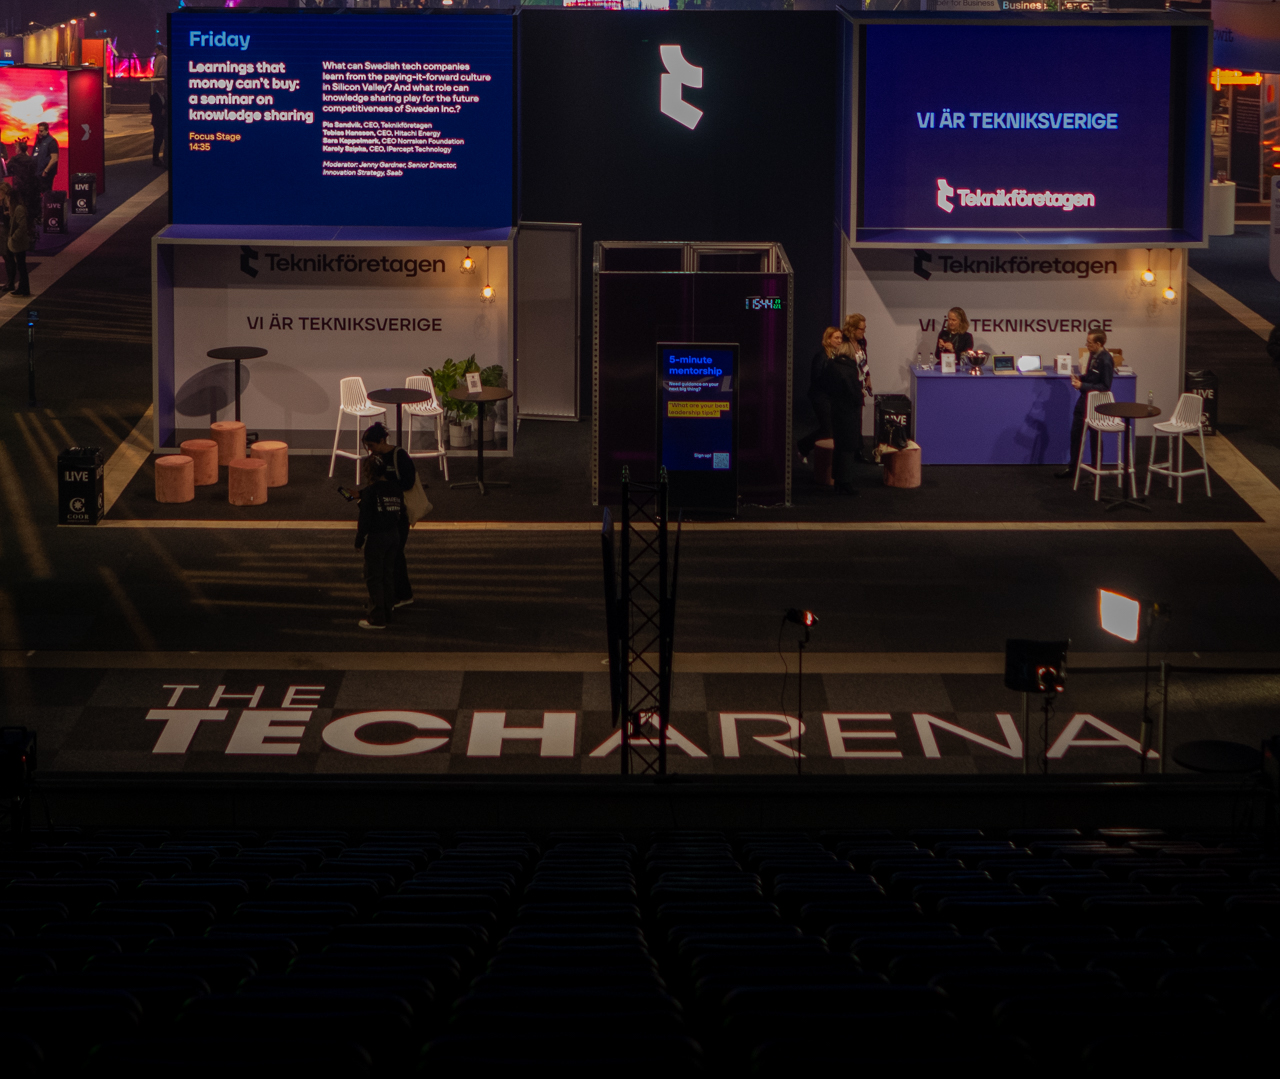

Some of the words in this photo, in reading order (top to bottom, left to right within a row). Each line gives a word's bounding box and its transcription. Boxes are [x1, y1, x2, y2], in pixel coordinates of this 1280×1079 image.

[189, 30, 251, 51] Friday
[188, 60, 255, 75] Learnings
[256, 61, 286, 73] that
[322, 61, 346, 70] What
[347, 62, 363, 70] can
[364, 61, 400, 70] Swedish
[401, 61, 421, 70] tech
[422, 62, 470, 72] companies
[322, 72, 345, 81] learn
[346, 72, 366, 81] from
[368, 72, 382, 81] the
[384, 73, 459, 83] paying-it-forward
[460, 73, 491, 82] culture
[188, 78, 234, 91] money
[235, 77, 270, 89] can't
[272, 77, 300, 92] buy:
[322, 82, 331, 91] in
[332, 82, 360, 91] Silicon
[362, 83, 392, 93] Valley?
[393, 83, 411, 91] And
[412, 83, 434, 92] what
[435, 83, 452, 92] role
[188, 94, 198, 105] a
[200, 92, 255, 105] seminar
[255, 94, 274, 105] on
[322, 93, 369, 104] knowledge
[370, 93, 402, 104] sharing
[403, 94, 421, 104] play
[422, 93, 435, 103] for
[436, 94, 451, 103] the
[452, 94, 480, 103] future
[322, 104, 393, 115] competitiveness
[394, 104, 404, 113] of
[405, 105, 439, 113] Sweden
[441, 105, 461, 114] Inc.?
[188, 108, 262, 123] knowledge
[263, 108, 315, 124] sharing
[917, 112, 935, 129] VI
[939, 108, 965, 129] ÄR
[969, 112, 1119, 130] TEKNIKSVERIGE
[363, 121, 380, 130] CEO,
[380, 122, 433, 131] Teknikföretagen
[189, 131, 215, 141] Focus
[216, 131, 241, 142] Stage
[377, 129, 393, 138] CEO,
[394, 129, 417, 137] Hitachi
[418, 130, 441, 139] Energy
[189, 142, 211, 151] 14:35
[381, 137, 397, 145] CEO
[428, 138, 465, 146] Foundation
[369, 145, 386, 154] CEO,
[415, 146, 452, 155] Technology
[322, 161, 358, 169] Moderator:
[359, 161, 379, 170] Jenny
[408, 161, 429, 169] Senior
[429, 161, 457, 170] Director,
[322, 169, 356, 177] Innovation
[386, 169, 404, 178] Saab
[956, 188, 1096, 211] Teknikföretagen
[265, 253, 446, 278] Teknikföretagen
[938, 255, 1117, 278] Teknikföretagen
[247, 316, 264, 330] VI
[269, 313, 293, 330] ÄR
[298, 317, 442, 332] TEKNIKSVERIGE
[919, 319, 935, 332] VI
[971, 319, 1113, 333] TEKNIKSVERIGE
[669, 355, 713, 364] 5-minute
[668, 367, 723, 377] mentorship
[681, 381, 703, 389] guidance
[668, 409, 701, 417] leadership
[65, 471, 89, 482] LIVE
[162, 684, 326, 709] THE
